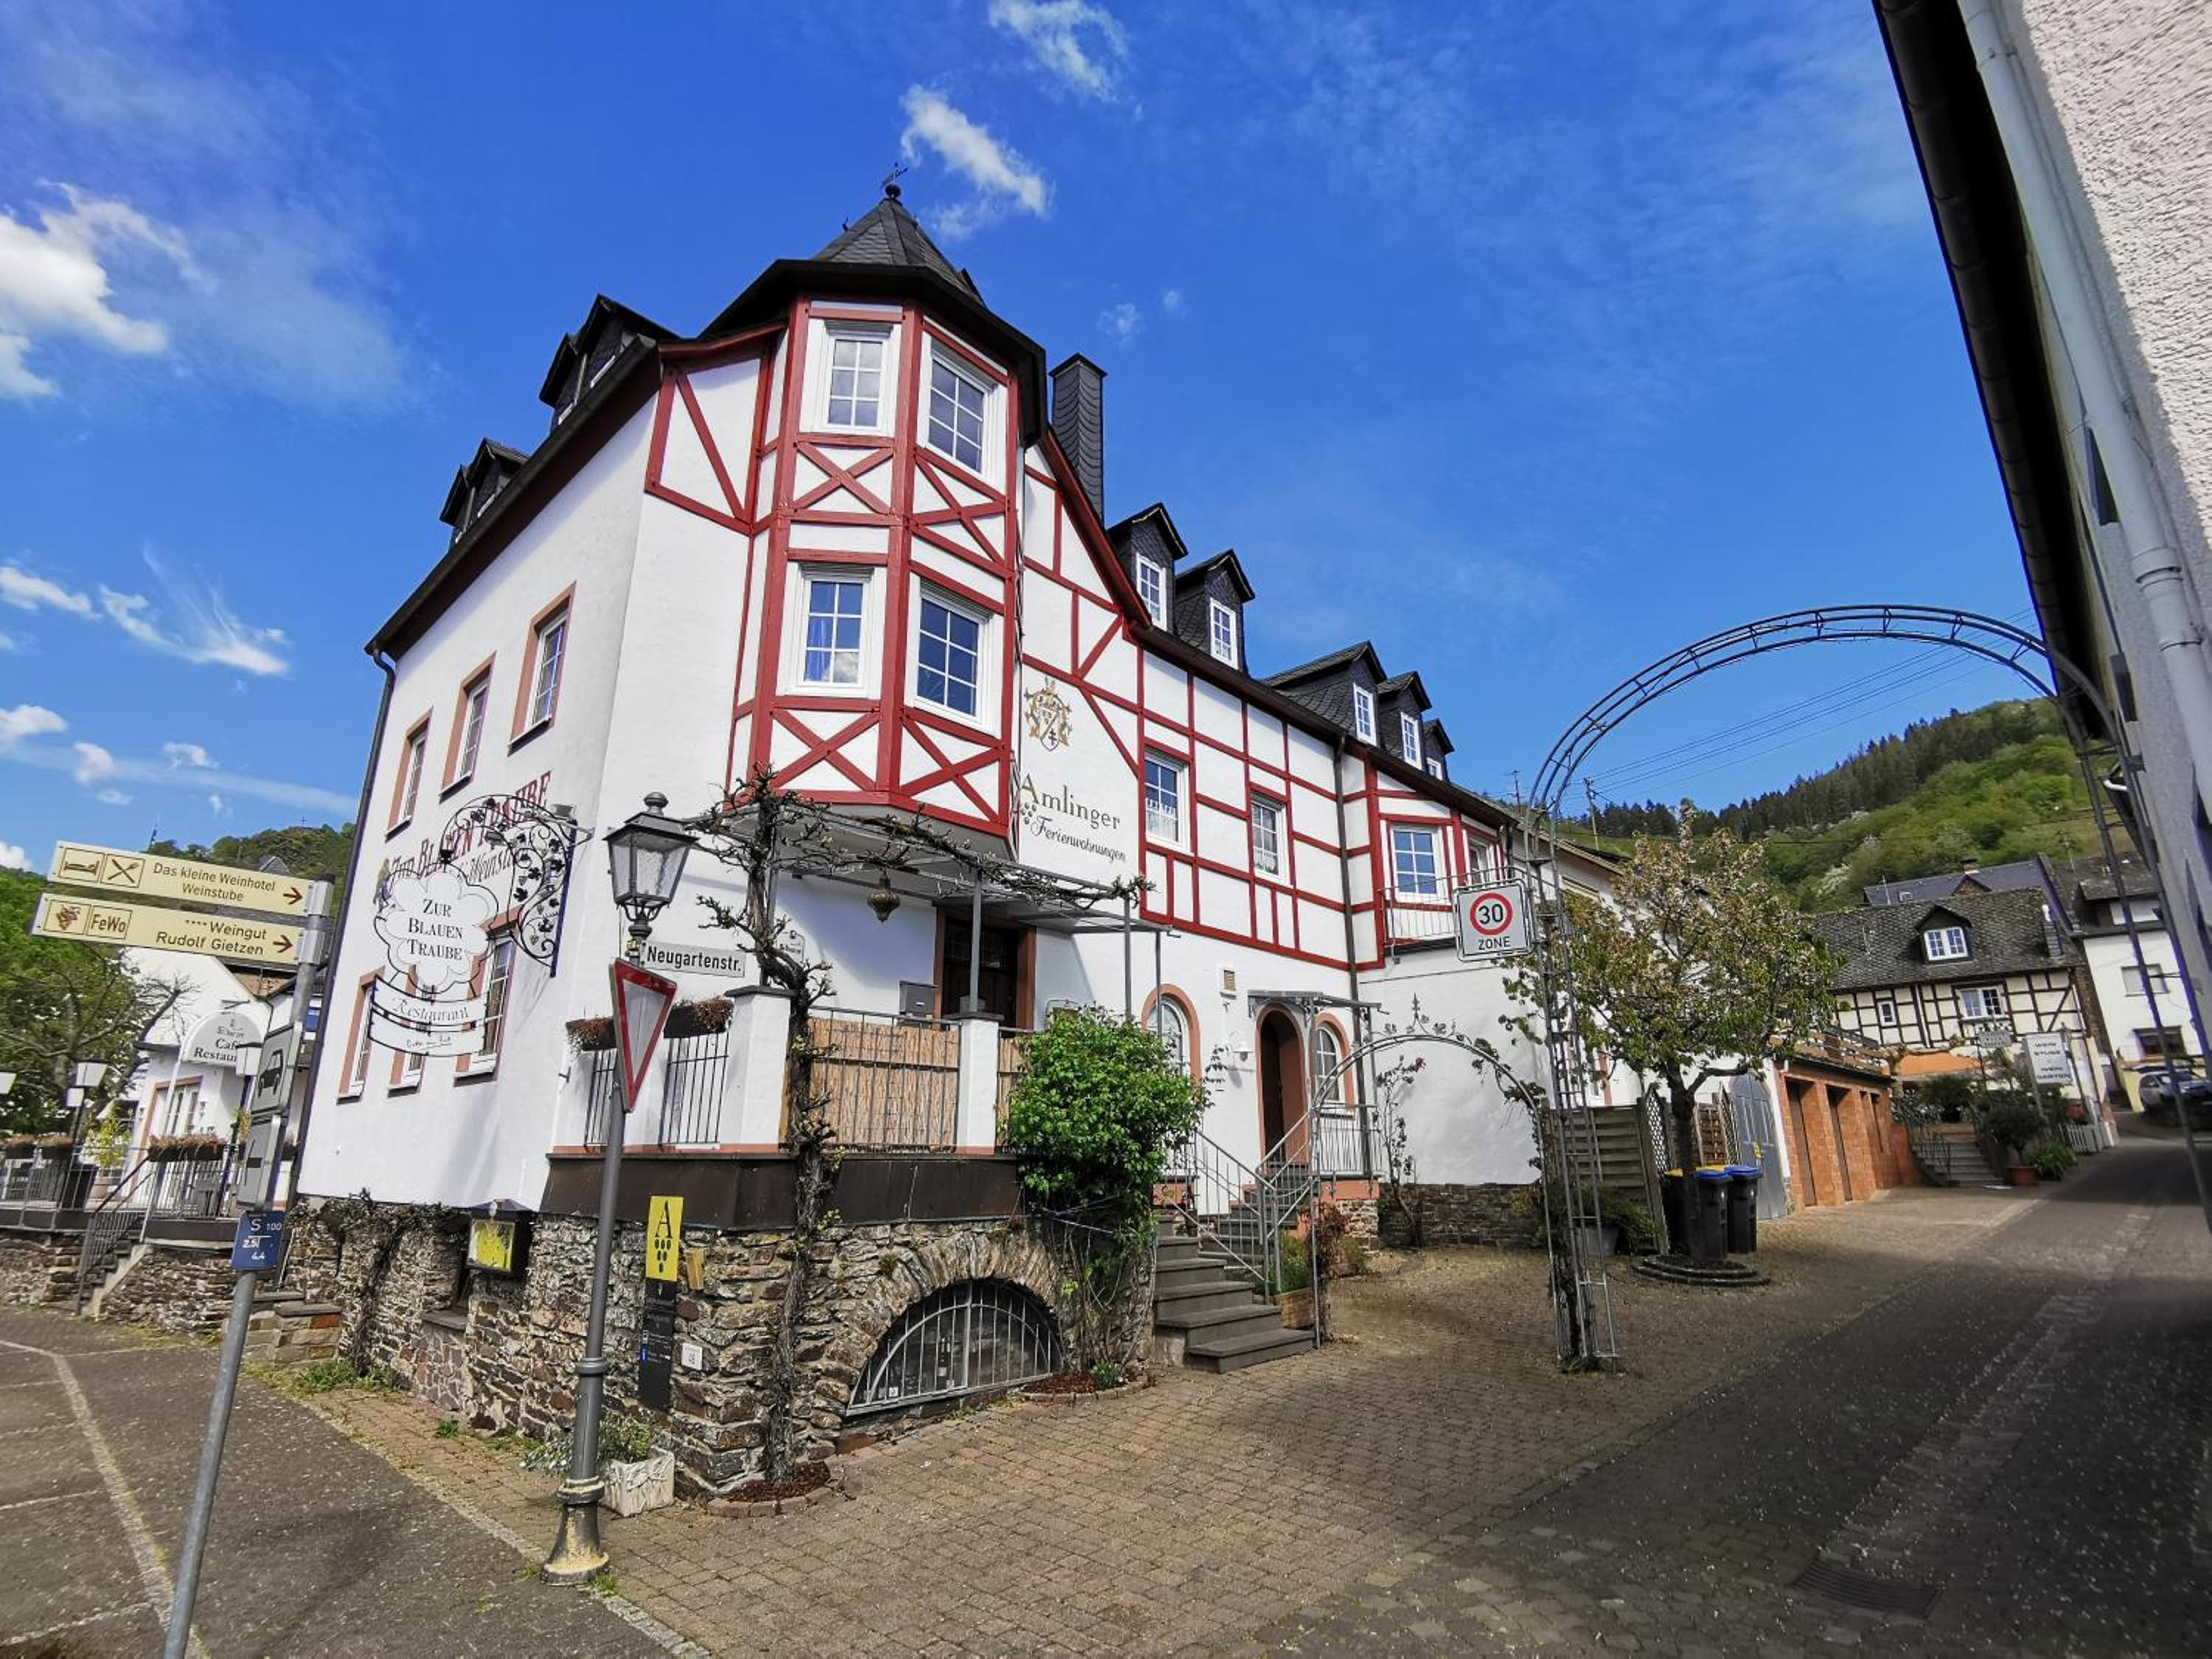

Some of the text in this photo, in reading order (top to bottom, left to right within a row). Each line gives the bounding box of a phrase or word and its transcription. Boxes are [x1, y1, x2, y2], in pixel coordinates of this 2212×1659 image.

[1021, 773, 1121, 830] Amlinger
[1030, 815, 1126, 863] Ferienwohnungen
[153, 862, 275, 891] Das kleine Weinhotel
[181, 883, 244, 901] Weinstube
[422, 898, 451, 918] ZUR
[1478, 903, 1503, 925] 30
[91, 914, 126, 933] FeWo
[210, 921, 267, 940] Weingut
[408, 917, 463, 939] BLAUEN
[156, 931, 263, 955] Rudolf Gietzen
[406, 939, 463, 960] TRAUBE
[1478, 936, 1511, 950] ZONE
[647, 945, 742, 972] Neugartenstr.
[393, 998, 469, 1021] Restaurant
[250, 1218, 262, 1231] S
[655, 1200, 672, 1238] A
